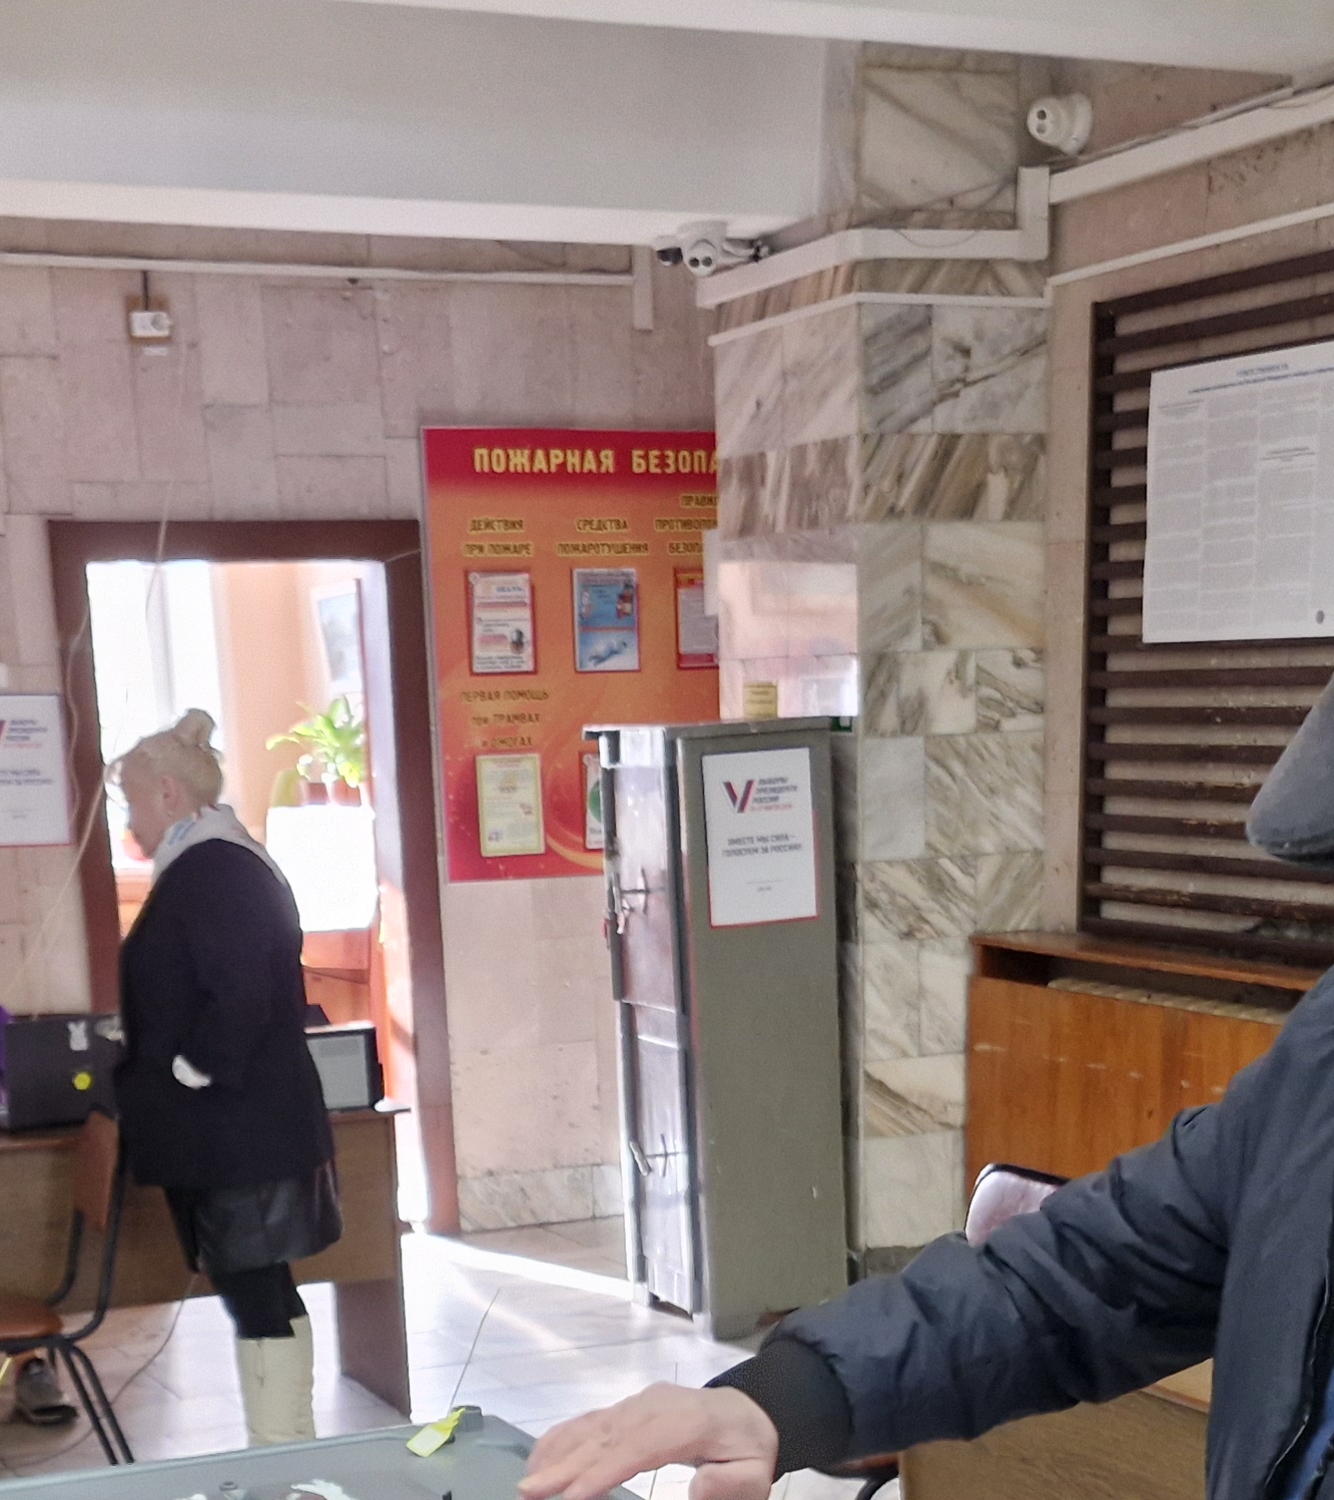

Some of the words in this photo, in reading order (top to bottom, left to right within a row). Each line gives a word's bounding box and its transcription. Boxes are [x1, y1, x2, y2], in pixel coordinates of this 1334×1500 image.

[473, 447, 616, 474] ПОЖАРНАЯ
[468, 516, 524, 533] ДЕЙСТВИЯ
[575, 517, 629, 533] СРЕДСТВА
[488, 542, 532, 557] ПОЖАРЕ
[556, 541, 649, 556] ПОЖАРОТУШЕНИЯ
